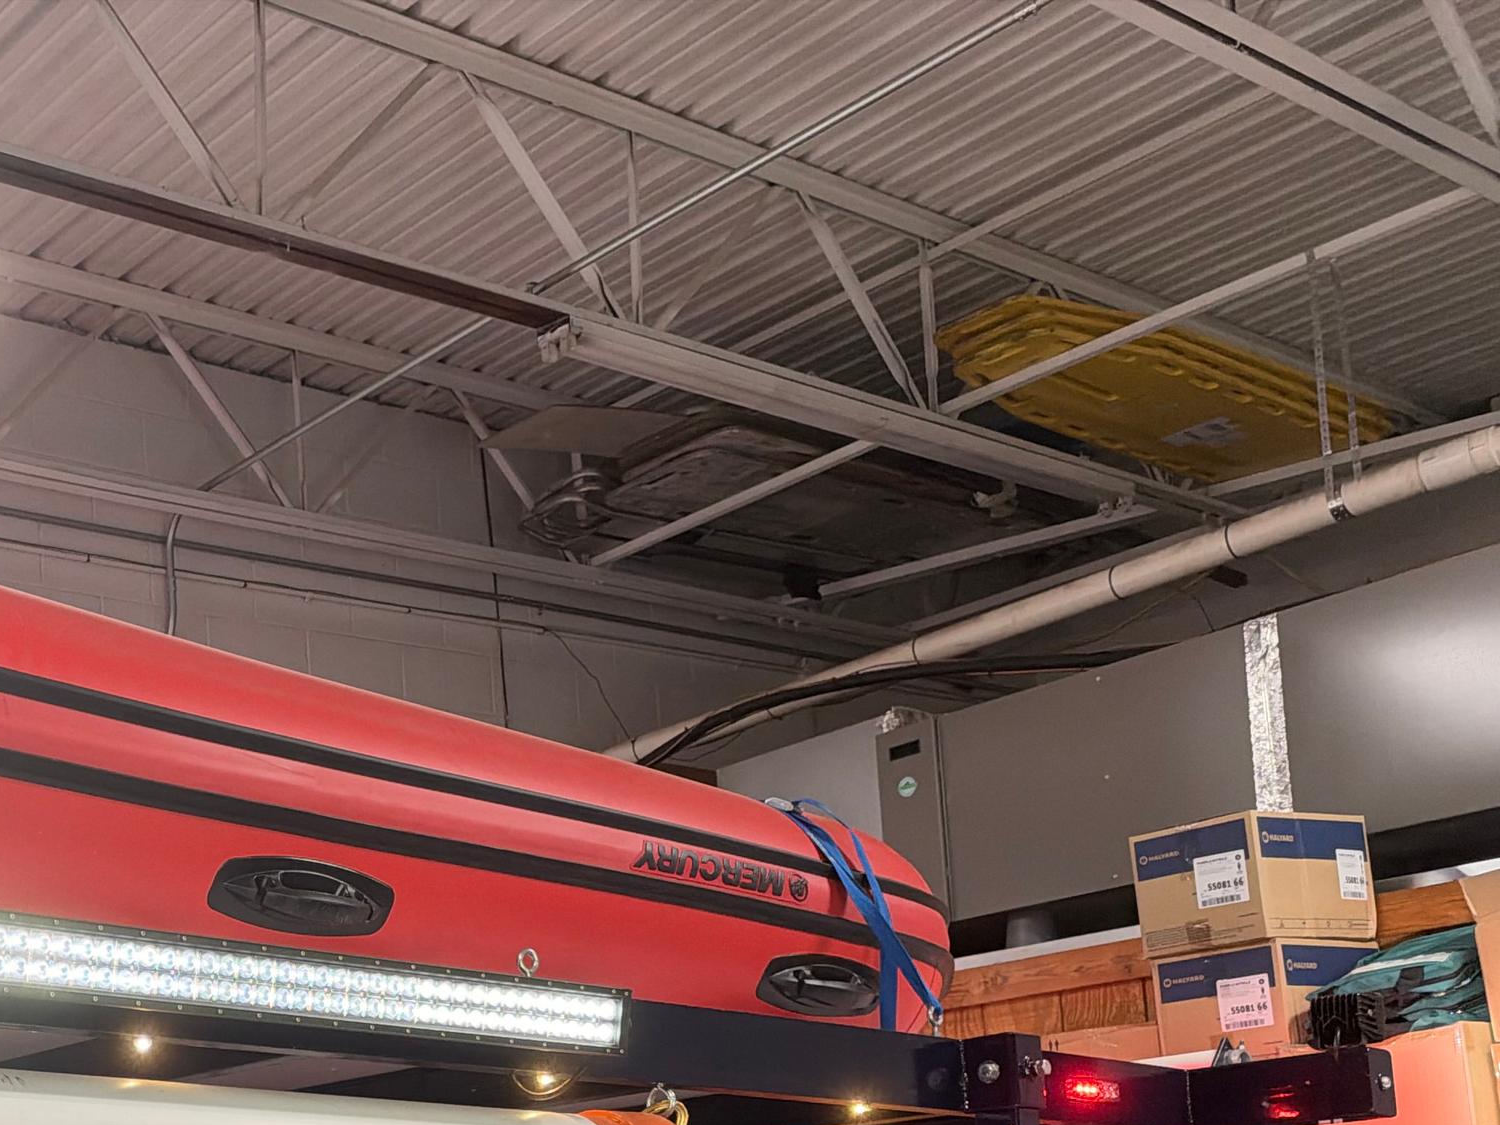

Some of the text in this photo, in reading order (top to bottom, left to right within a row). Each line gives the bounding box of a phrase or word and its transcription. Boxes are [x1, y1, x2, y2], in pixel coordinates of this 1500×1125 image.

[1148, 850, 1180, 862] HALYARD
[633, 840, 786, 897] MERCURY
[1207, 877, 1244, 892] 55081 66
[1172, 974, 1205, 985] HALYARD
[1231, 1001, 1268, 1015] 55081 66
